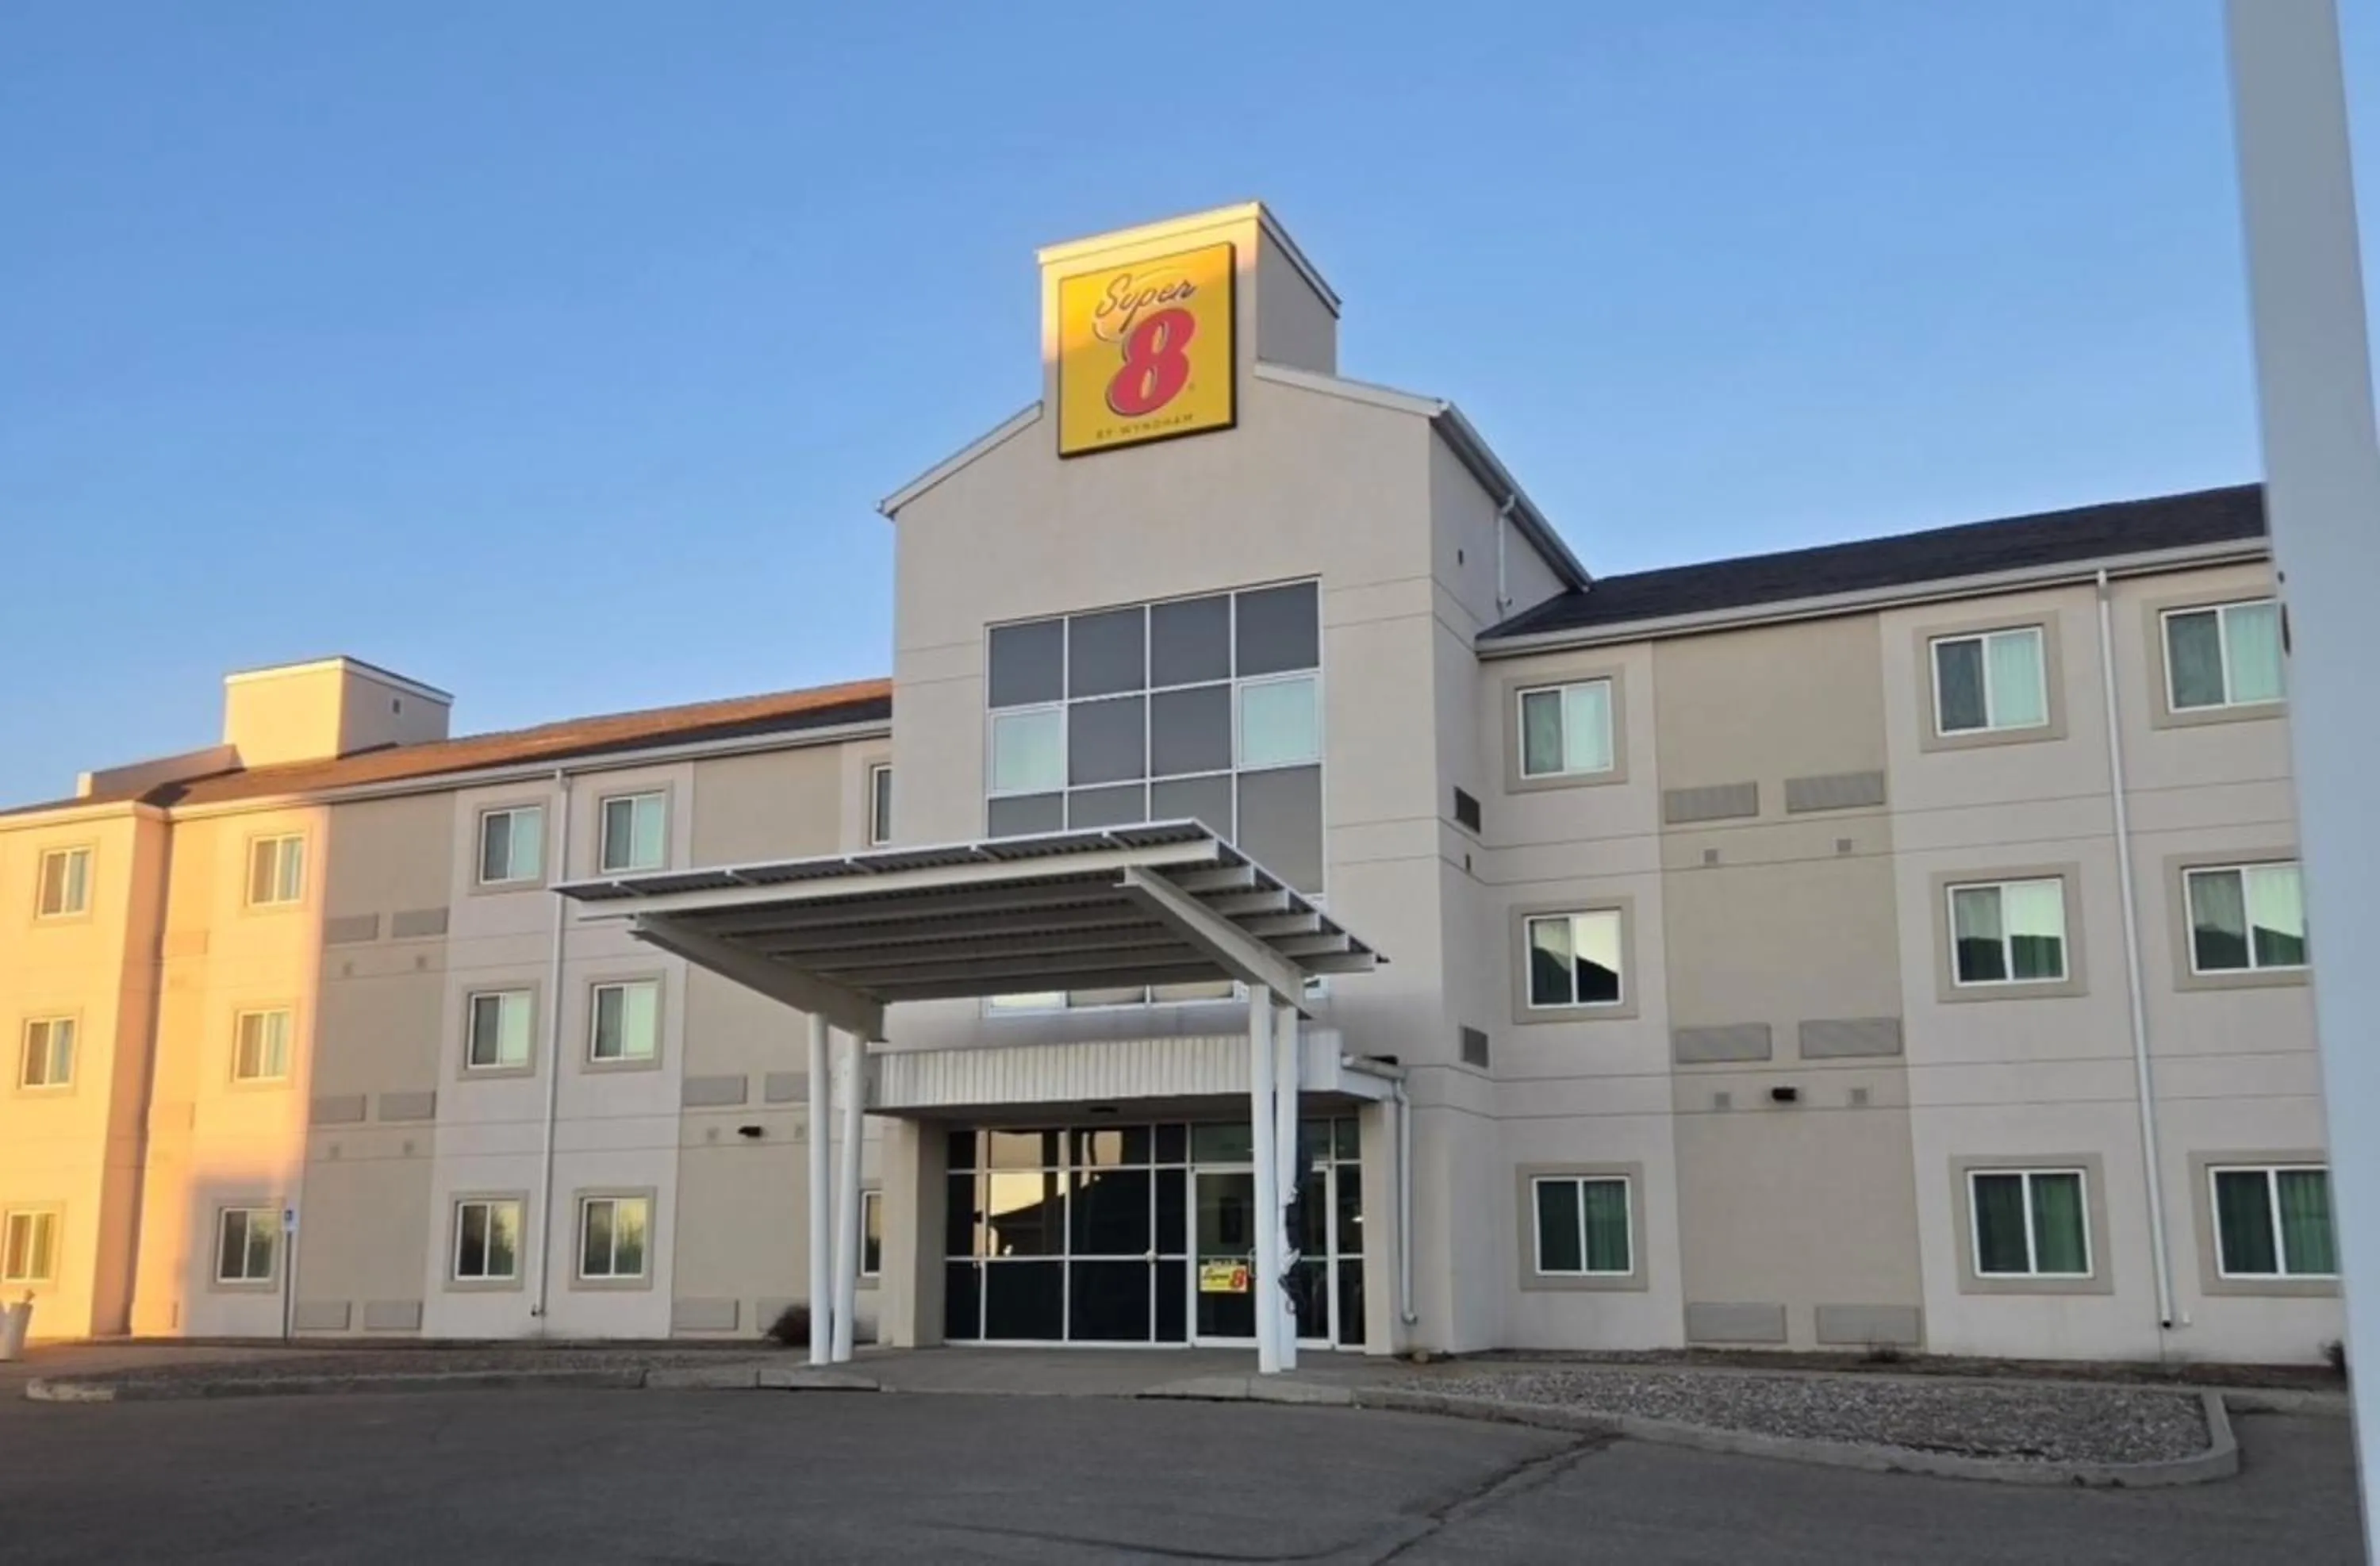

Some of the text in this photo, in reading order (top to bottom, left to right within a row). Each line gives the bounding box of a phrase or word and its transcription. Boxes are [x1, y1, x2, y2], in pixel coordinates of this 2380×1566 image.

[1095, 273, 1197, 334] Super
[1105, 306, 1196, 416] 8
[1120, 413, 1194, 435] WYNDHAM
